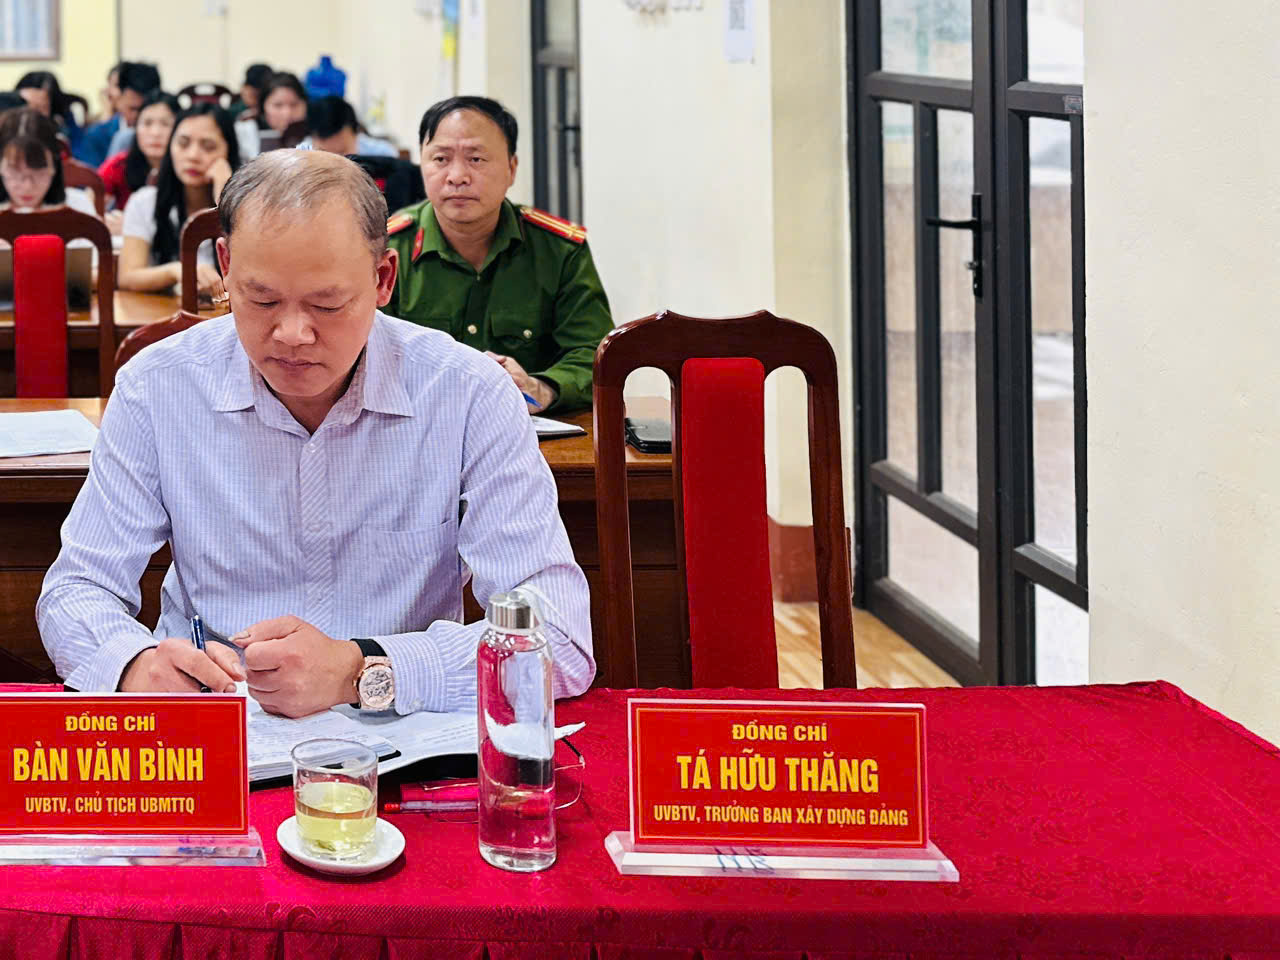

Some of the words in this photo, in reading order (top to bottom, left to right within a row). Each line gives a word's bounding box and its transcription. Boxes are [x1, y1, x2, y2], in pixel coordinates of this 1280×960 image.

[65, 711, 118, 732] ĐỒNG
[123, 712, 155, 732] CHÍ
[731, 719, 788, 741] ĐỒNG
[793, 722, 827, 742] CHÍ
[13, 740, 69, 781] BÀN
[76, 740, 130, 781] VĂN
[139, 740, 204, 781] BÌNH
[676, 749, 712, 790] TÁ
[719, 748, 776, 792] HỮU
[784, 751, 879, 793] THĂNG
[25, 797, 71, 814] UVBTV,
[75, 791, 103, 814] CHỦ
[106, 797, 136, 817] TỊCH
[140, 797, 195, 814] UBMTTQ
[654, 805, 701, 823] UVBTV,
[704, 800, 759, 823] TRƯỞNG
[763, 807, 793, 824] BAN
[796, 804, 823, 824] XÂY
[827, 807, 866, 828] DỰNG
[869, 803, 908, 826] ĐẢNG
